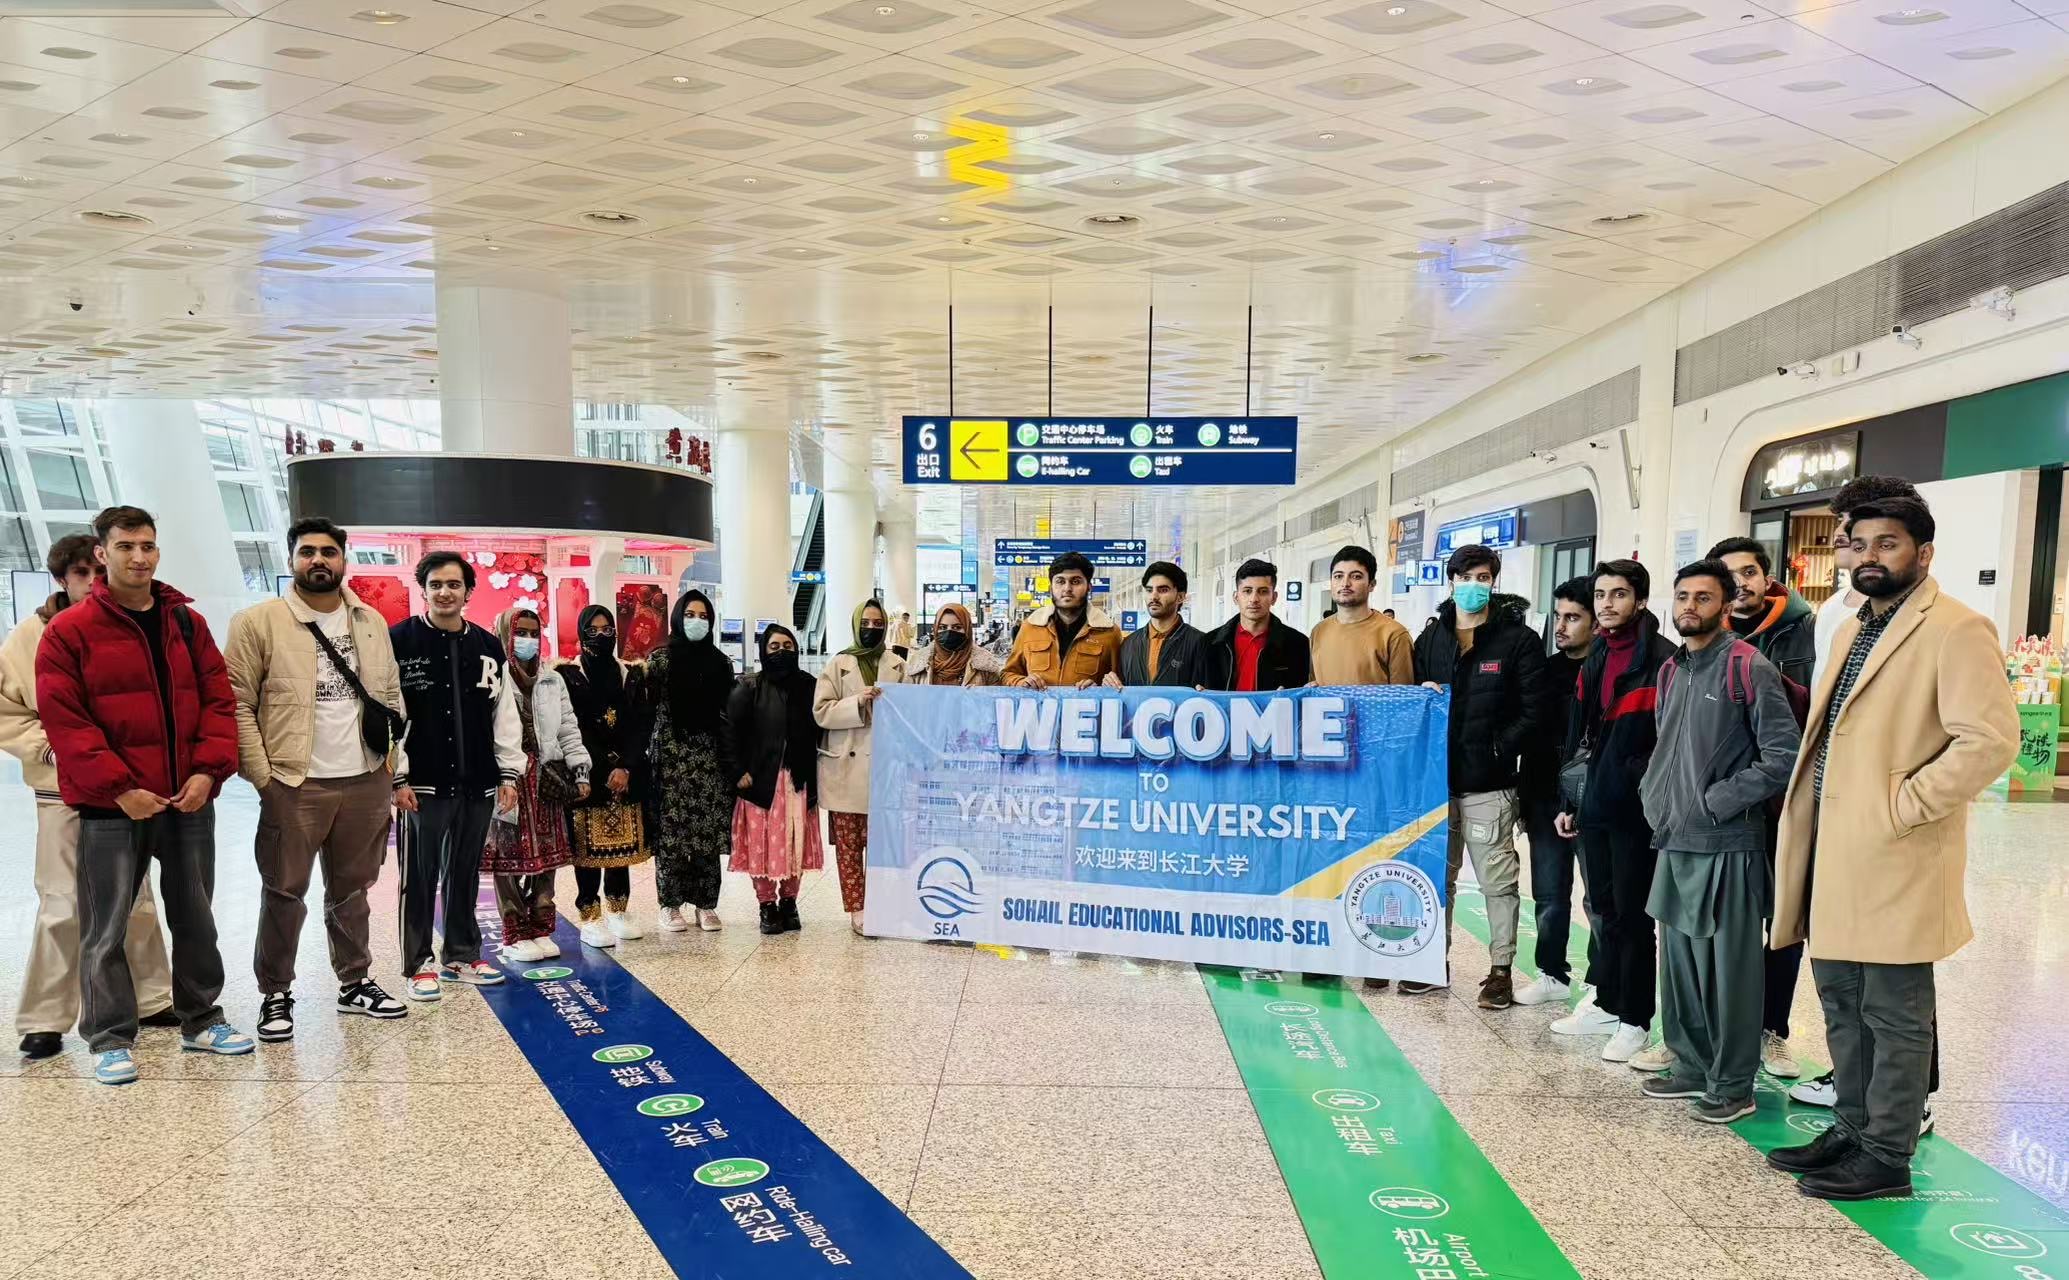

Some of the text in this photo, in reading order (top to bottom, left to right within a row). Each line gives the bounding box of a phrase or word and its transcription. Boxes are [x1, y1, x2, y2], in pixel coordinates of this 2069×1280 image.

[918, 424, 937, 450] 6
[1041, 424, 1106, 435] 交通中心停车场
[1041, 435, 1125, 446] Traffic Center Parking
[1155, 424, 1174, 435] 火车
[1155, 435, 1174, 445] Train
[1228, 424, 1248, 435] 地铁
[1228, 435, 1260, 446] Subway
[916, 453, 940, 467] 出口
[1154, 456, 1182, 467] 出租车
[917, 466, 940, 479] Exit
[1076, 467, 1091, 477] Car
[1154, 467, 1171, 477] Taxi
[995, 696, 1348, 762] WELCOME
[1139, 772, 1169, 793] TO
[952, 790, 1358, 842] YANGTZE UNIVERSITY
[1074, 844, 1250, 878] 欢迎来到长江大学
[1351, 869, 1433, 914] YANGTZE UNIVERSITY
[933, 922, 961, 938] SEA
[1002, 897, 1331, 947] SOHAIL EDUCATIONAL ADVISORS-SEA
[610, 1065, 654, 1088] 地铁
[645, 1059, 677, 1083] Subway
[660, 1122, 709, 1148] 火车
[701, 1117, 729, 1140] Train
[1330, 1115, 1384, 1156] 出租车
[1376, 1125, 1403, 1145] Taxi
[719, 1191, 793, 1244] 网约车
[765, 1185, 852, 1265] Ride-Hailing car
[1443, 1232, 1490, 1278] Airport
